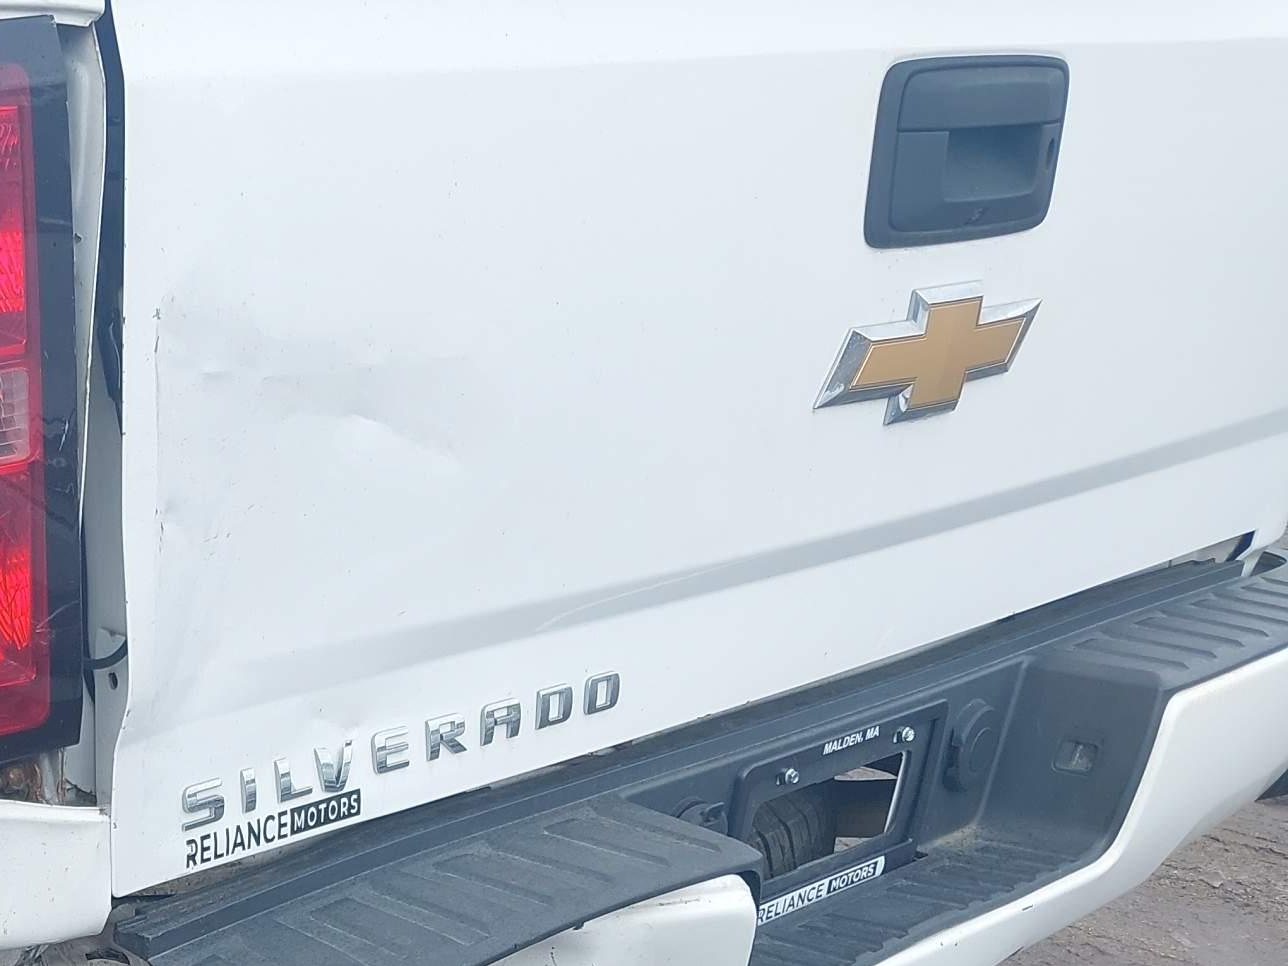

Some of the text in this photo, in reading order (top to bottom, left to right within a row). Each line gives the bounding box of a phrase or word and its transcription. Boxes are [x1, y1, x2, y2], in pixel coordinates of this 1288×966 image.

[182, 670, 622, 832] SILVERADO
[823, 725, 880, 756] MALDEN, MA
[185, 794, 359, 869] RELIANCE MOTORS
[758, 863, 876, 923] RELIANCE MOTORS
